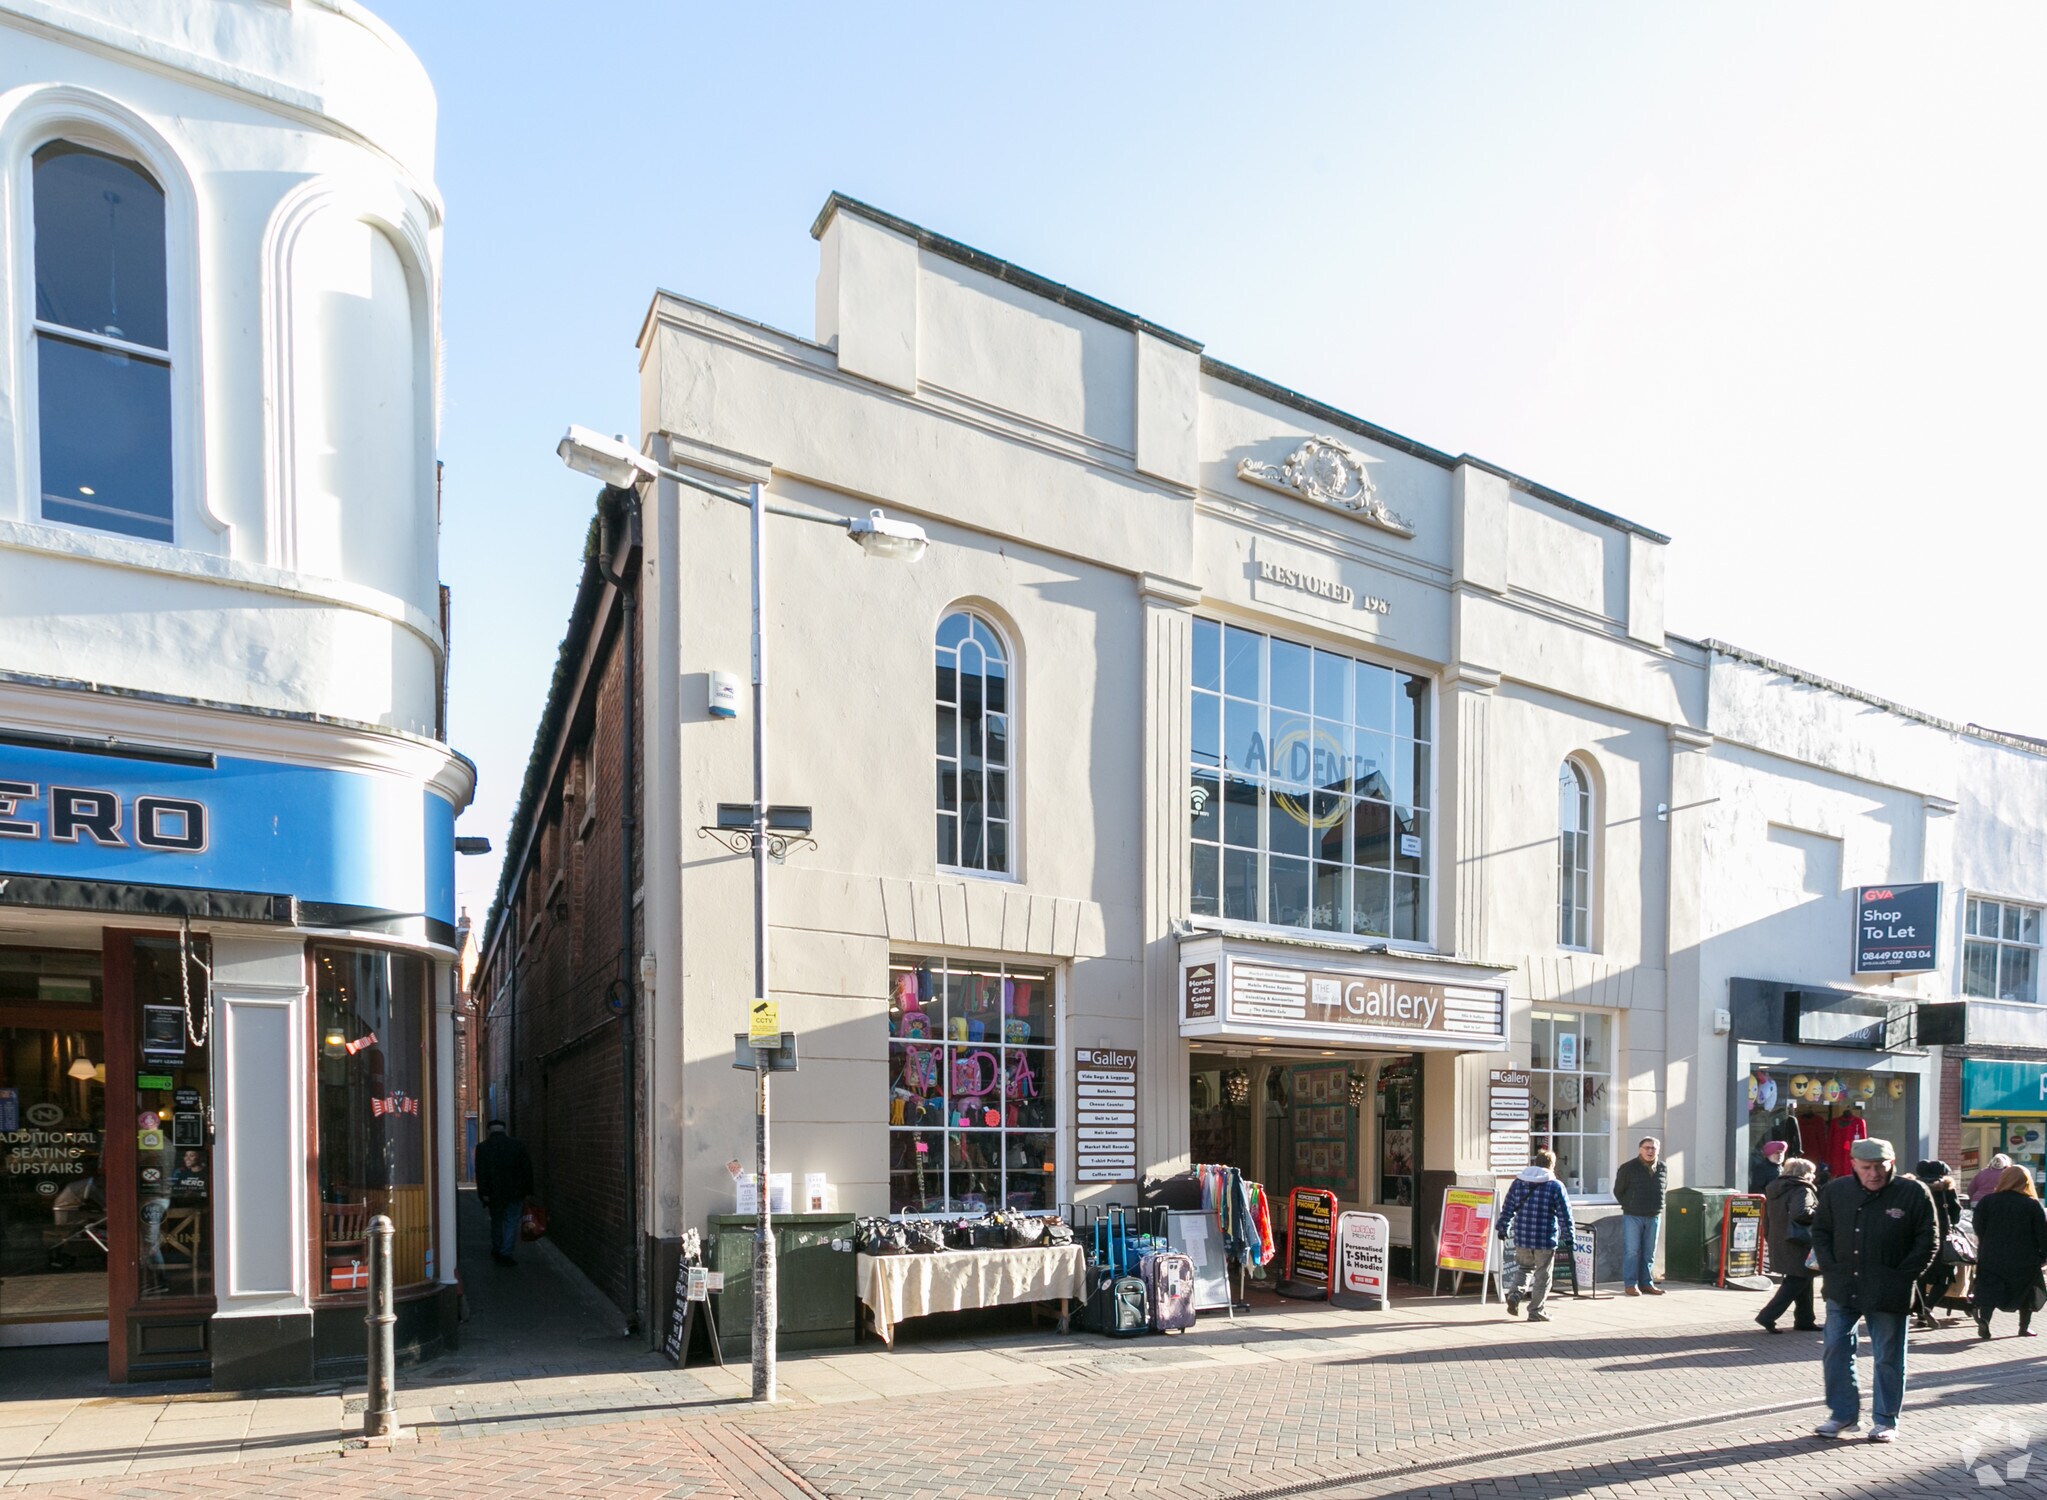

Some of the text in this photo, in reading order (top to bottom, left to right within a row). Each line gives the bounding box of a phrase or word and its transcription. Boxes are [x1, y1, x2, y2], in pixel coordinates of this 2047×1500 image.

[1260, 560, 1355, 604] RESTORED
[1245, 731, 1377, 785] AL DENTE
[1863, 889, 1894, 901] GVA
[1863, 909, 1902, 923] Shop
[1863, 926, 1916, 940] To Let
[1862, 950, 1931, 961] 08449 02 03 04
[1191, 995, 1212, 1003] Coffee
[1344, 981, 1439, 1029] Gallery
[1092, 1050, 1136, 1069] Gallery
[905, 1045, 1038, 1097] VIDA
[1500, 1071, 1530, 1086] Gallery
[0, 1131, 97, 1144] ADDITIONAL
[11, 1147, 81, 1159] SEATING
[10, 1162, 84, 1174] UPSTAIRS
[181, 1179, 205, 1187] NERO
[1297, 1201, 1315, 1209] PHONE
[1345, 1243, 1383, 1253] Personalised
[1346, 1250, 1383, 1264] T-Shirts
[1354, 1261, 1383, 1271] Hoodies
